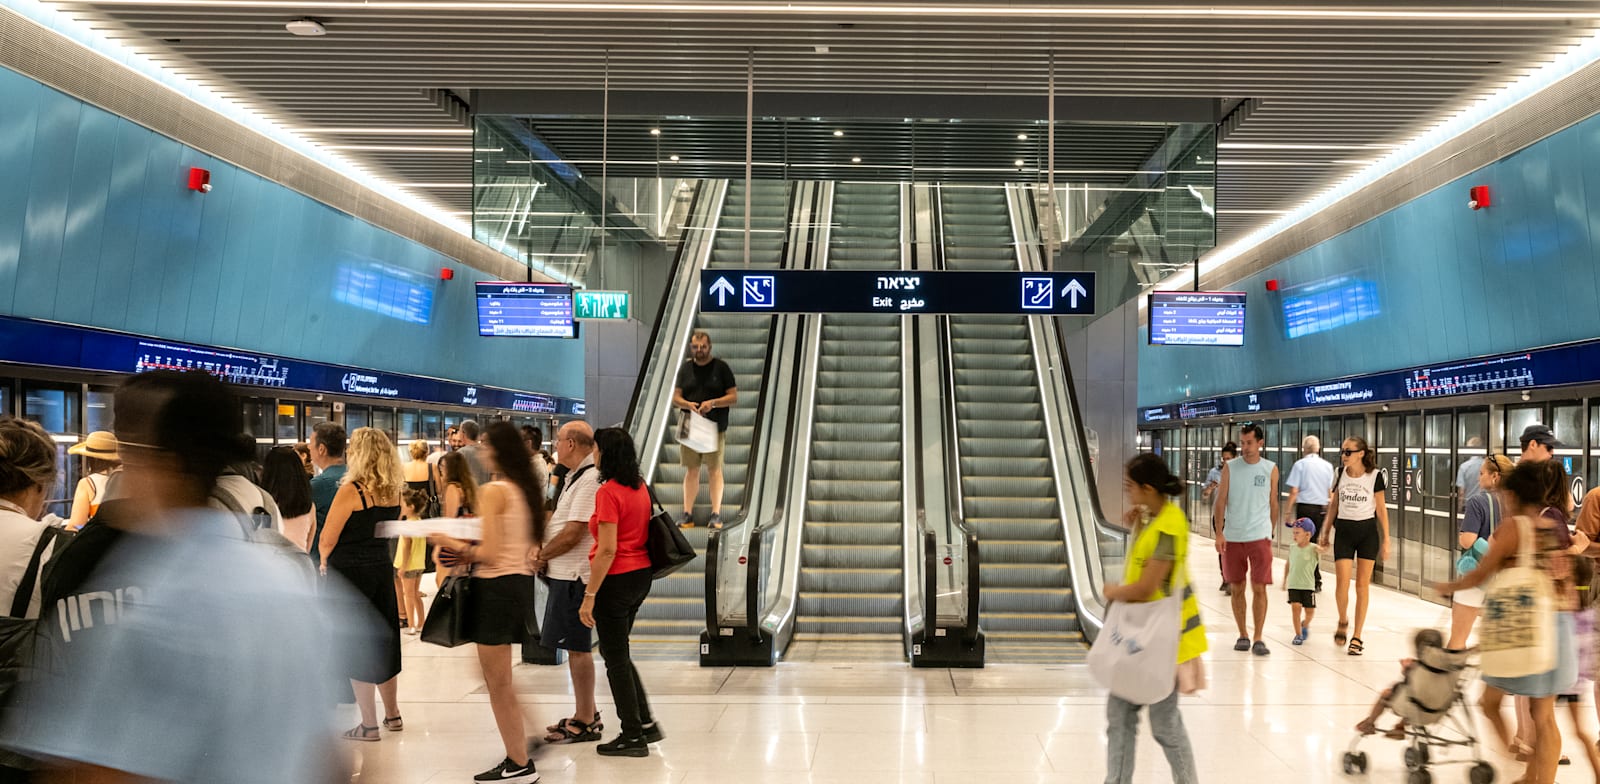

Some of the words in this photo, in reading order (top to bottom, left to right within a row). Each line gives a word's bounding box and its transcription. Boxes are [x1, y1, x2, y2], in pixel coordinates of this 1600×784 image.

[877, 277, 920, 289] יציאה
[593, 293, 626, 318] יציאה
[872, 297, 892, 306] Exit
[900, 297, 924, 310] مخرج
